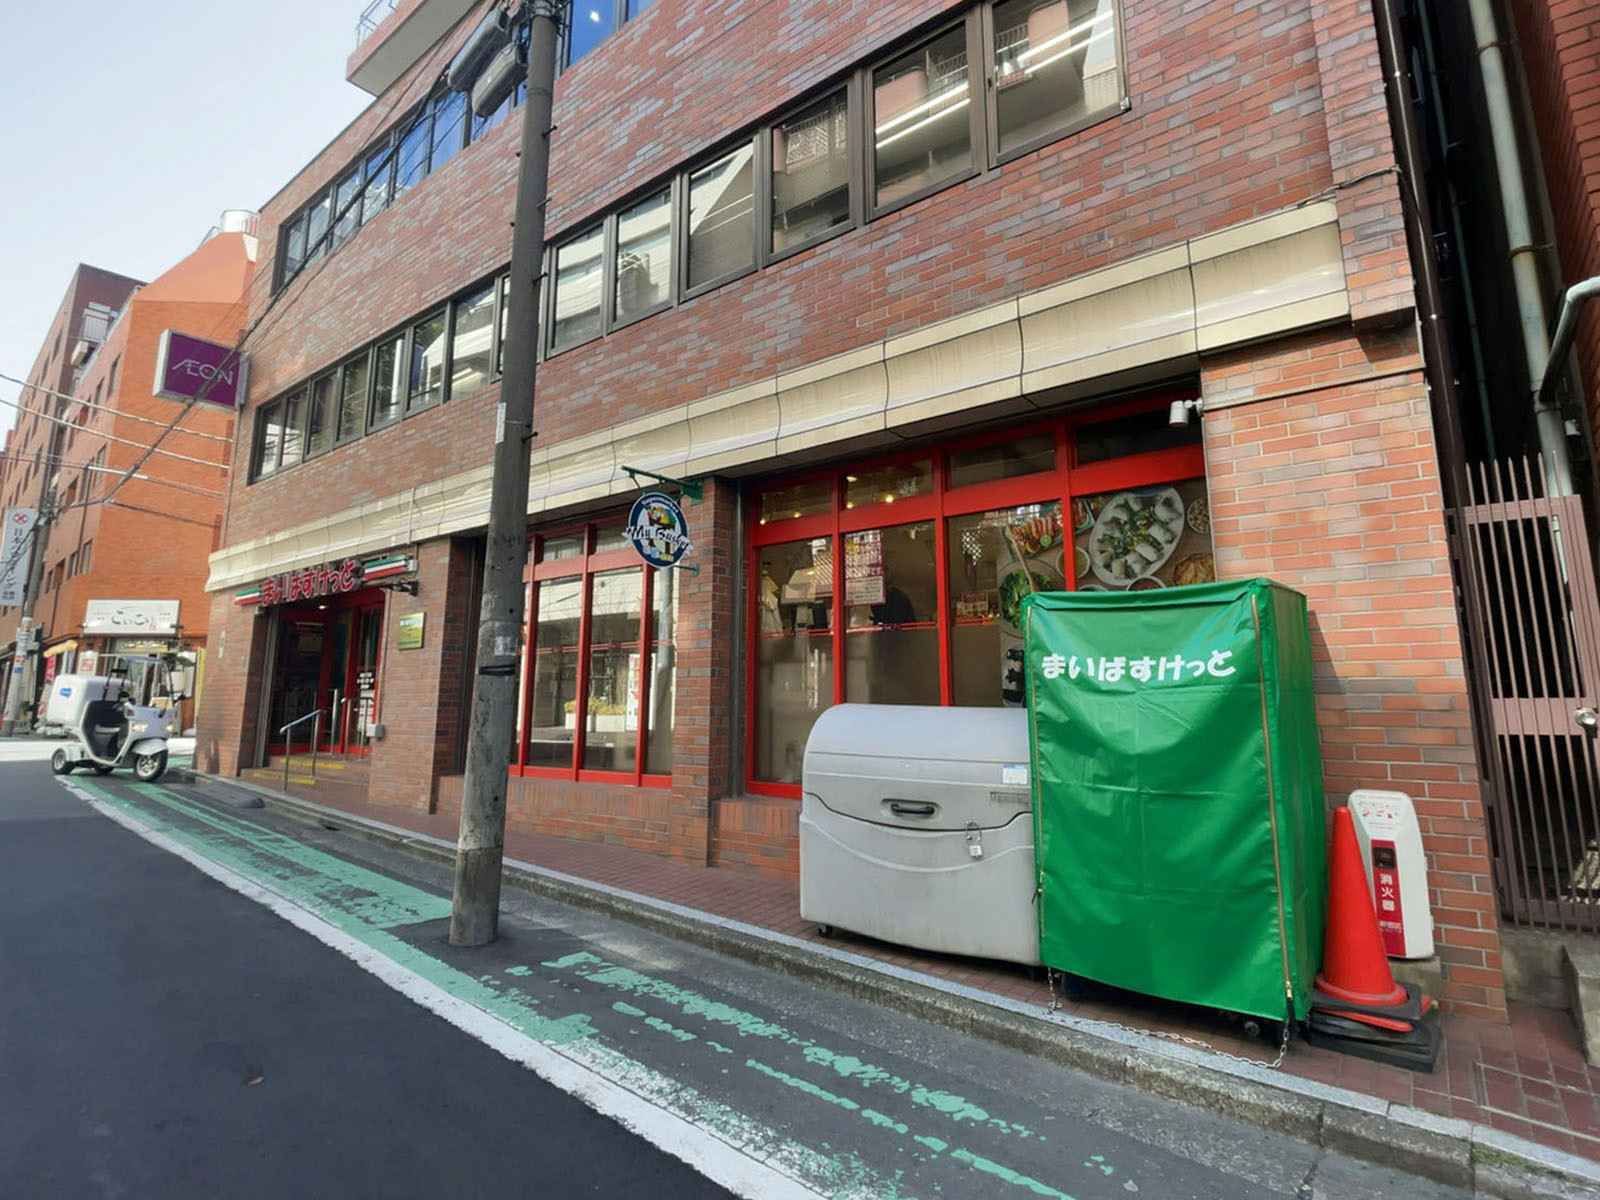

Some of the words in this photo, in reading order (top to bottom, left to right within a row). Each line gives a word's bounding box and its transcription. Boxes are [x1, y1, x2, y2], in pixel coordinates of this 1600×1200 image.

[626, 525, 651, 540] My
[655, 527, 690, 550] Basket
[262, 558, 354, 606] まいばすけっと
[1041, 649, 1237, 683] まいばすけっと
